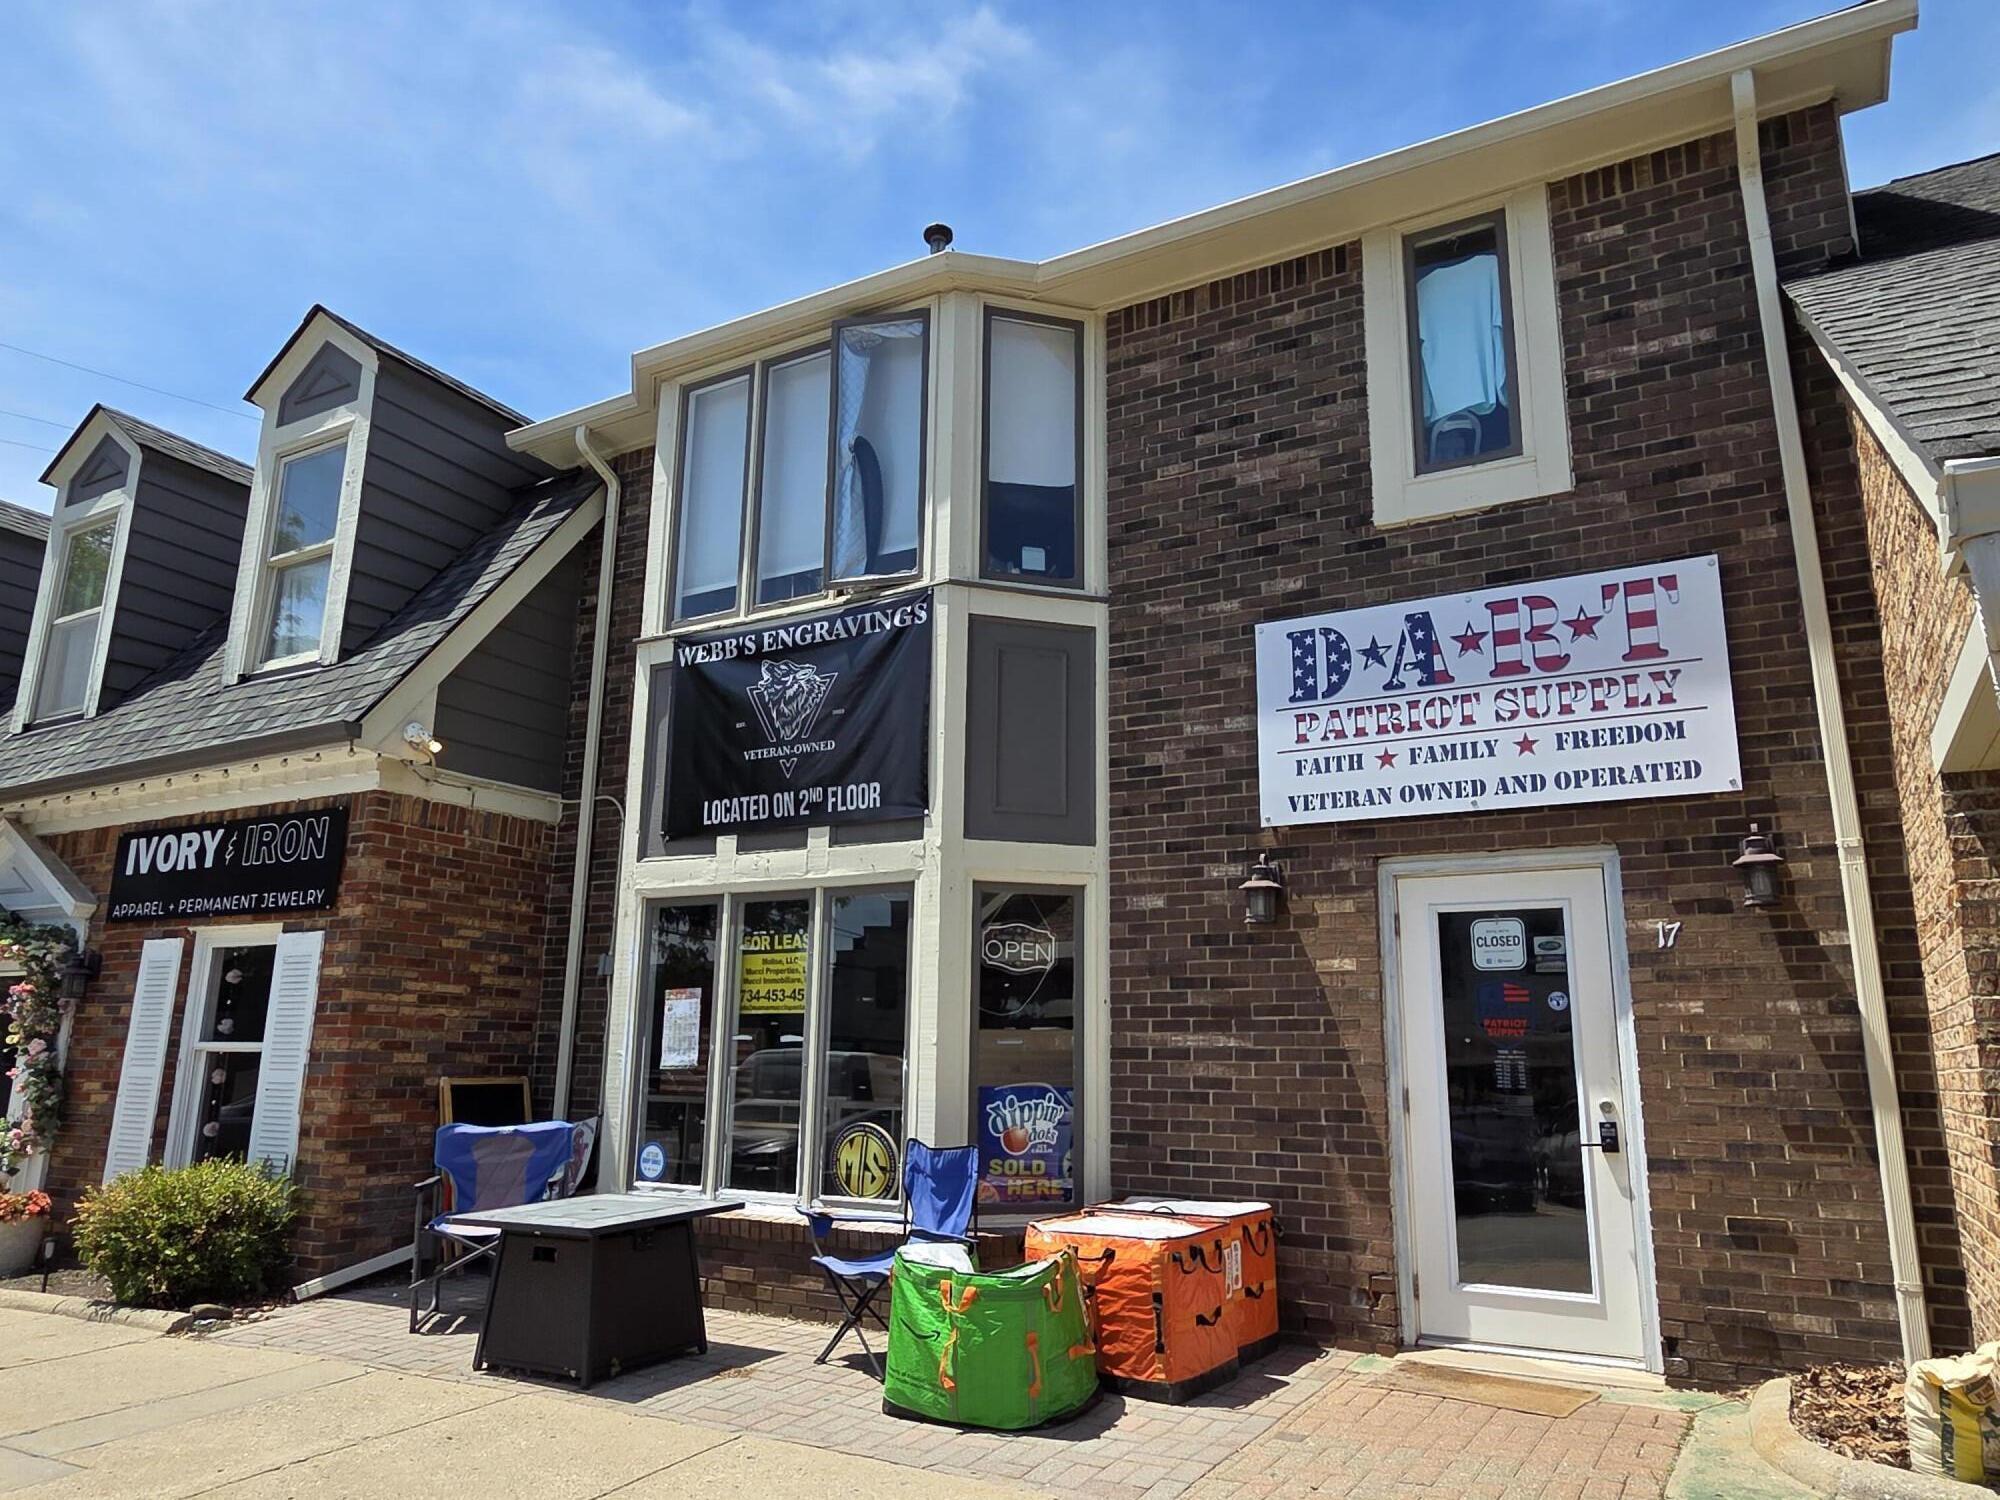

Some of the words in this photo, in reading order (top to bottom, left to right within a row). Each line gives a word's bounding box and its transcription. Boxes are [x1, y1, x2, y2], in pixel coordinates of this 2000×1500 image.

[677, 634, 756, 667] WEBB'S
[762, 602, 928, 652] ENGRAVINGS
[1294, 692, 1482, 744] PATRIOT
[1494, 668, 1682, 723] SUPPLY
[743, 740, 836, 760] VETERAN-OWNED
[1295, 753, 1364, 776] FAITH
[1409, 739, 1499, 766] FAMILY
[1555, 720, 1687, 751] FREEDOM
[1288, 787, 1392, 813] VETERAN
[1400, 773, 1486, 802] OWNED
[1494, 770, 1547, 796] AND
[1554, 759, 1703, 791] OPERATED
[703, 793, 769, 825] LOCATED
[774, 791, 795, 817] ON
[827, 782, 881, 813] FLOOR
[125, 828, 225, 876] IVORY
[242, 817, 330, 866] IRON
[112, 901, 165, 918] APPAREL
[178, 894, 258, 913] PERMANENT
[261, 889, 325, 908] JEWELRY
[1476, 935, 1520, 948] CLOSED
[1657, 921, 1681, 948] 17
[985, 939, 1052, 962] OPEN
[1483, 1019, 1527, 1028] PATRIOT
[989, 1159, 1046, 1175] SOLD
[1007, 1179, 1064, 1195] HERE
